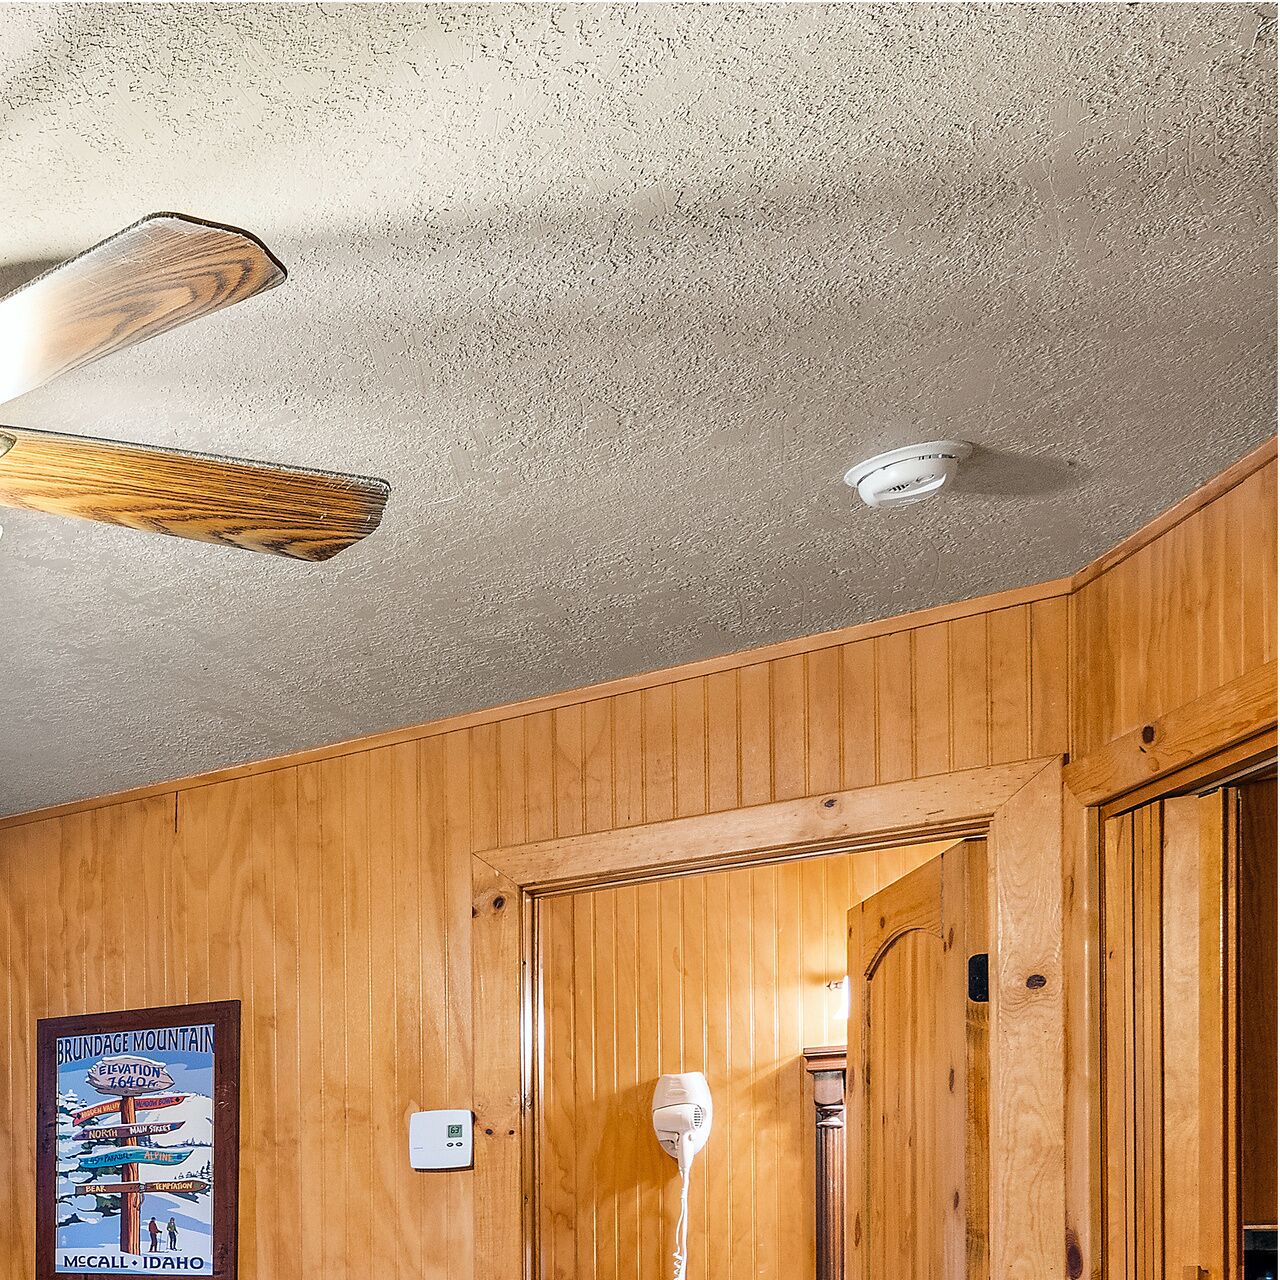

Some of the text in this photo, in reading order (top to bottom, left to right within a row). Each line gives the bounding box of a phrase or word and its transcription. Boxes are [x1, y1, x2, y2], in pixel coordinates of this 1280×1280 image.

[57, 1026, 215, 1066] BRUNDAGE MOUNTAIN
[98, 1063, 161, 1078] ELEVATION
[88, 1129, 118, 1139] NORTH
[129, 1123, 171, 1135] MAIN STREET
[143, 1151, 174, 1162] ALPINE
[153, 1182, 193, 1190] TEMPTATION
[143, 1256, 204, 1270] IDAHO
